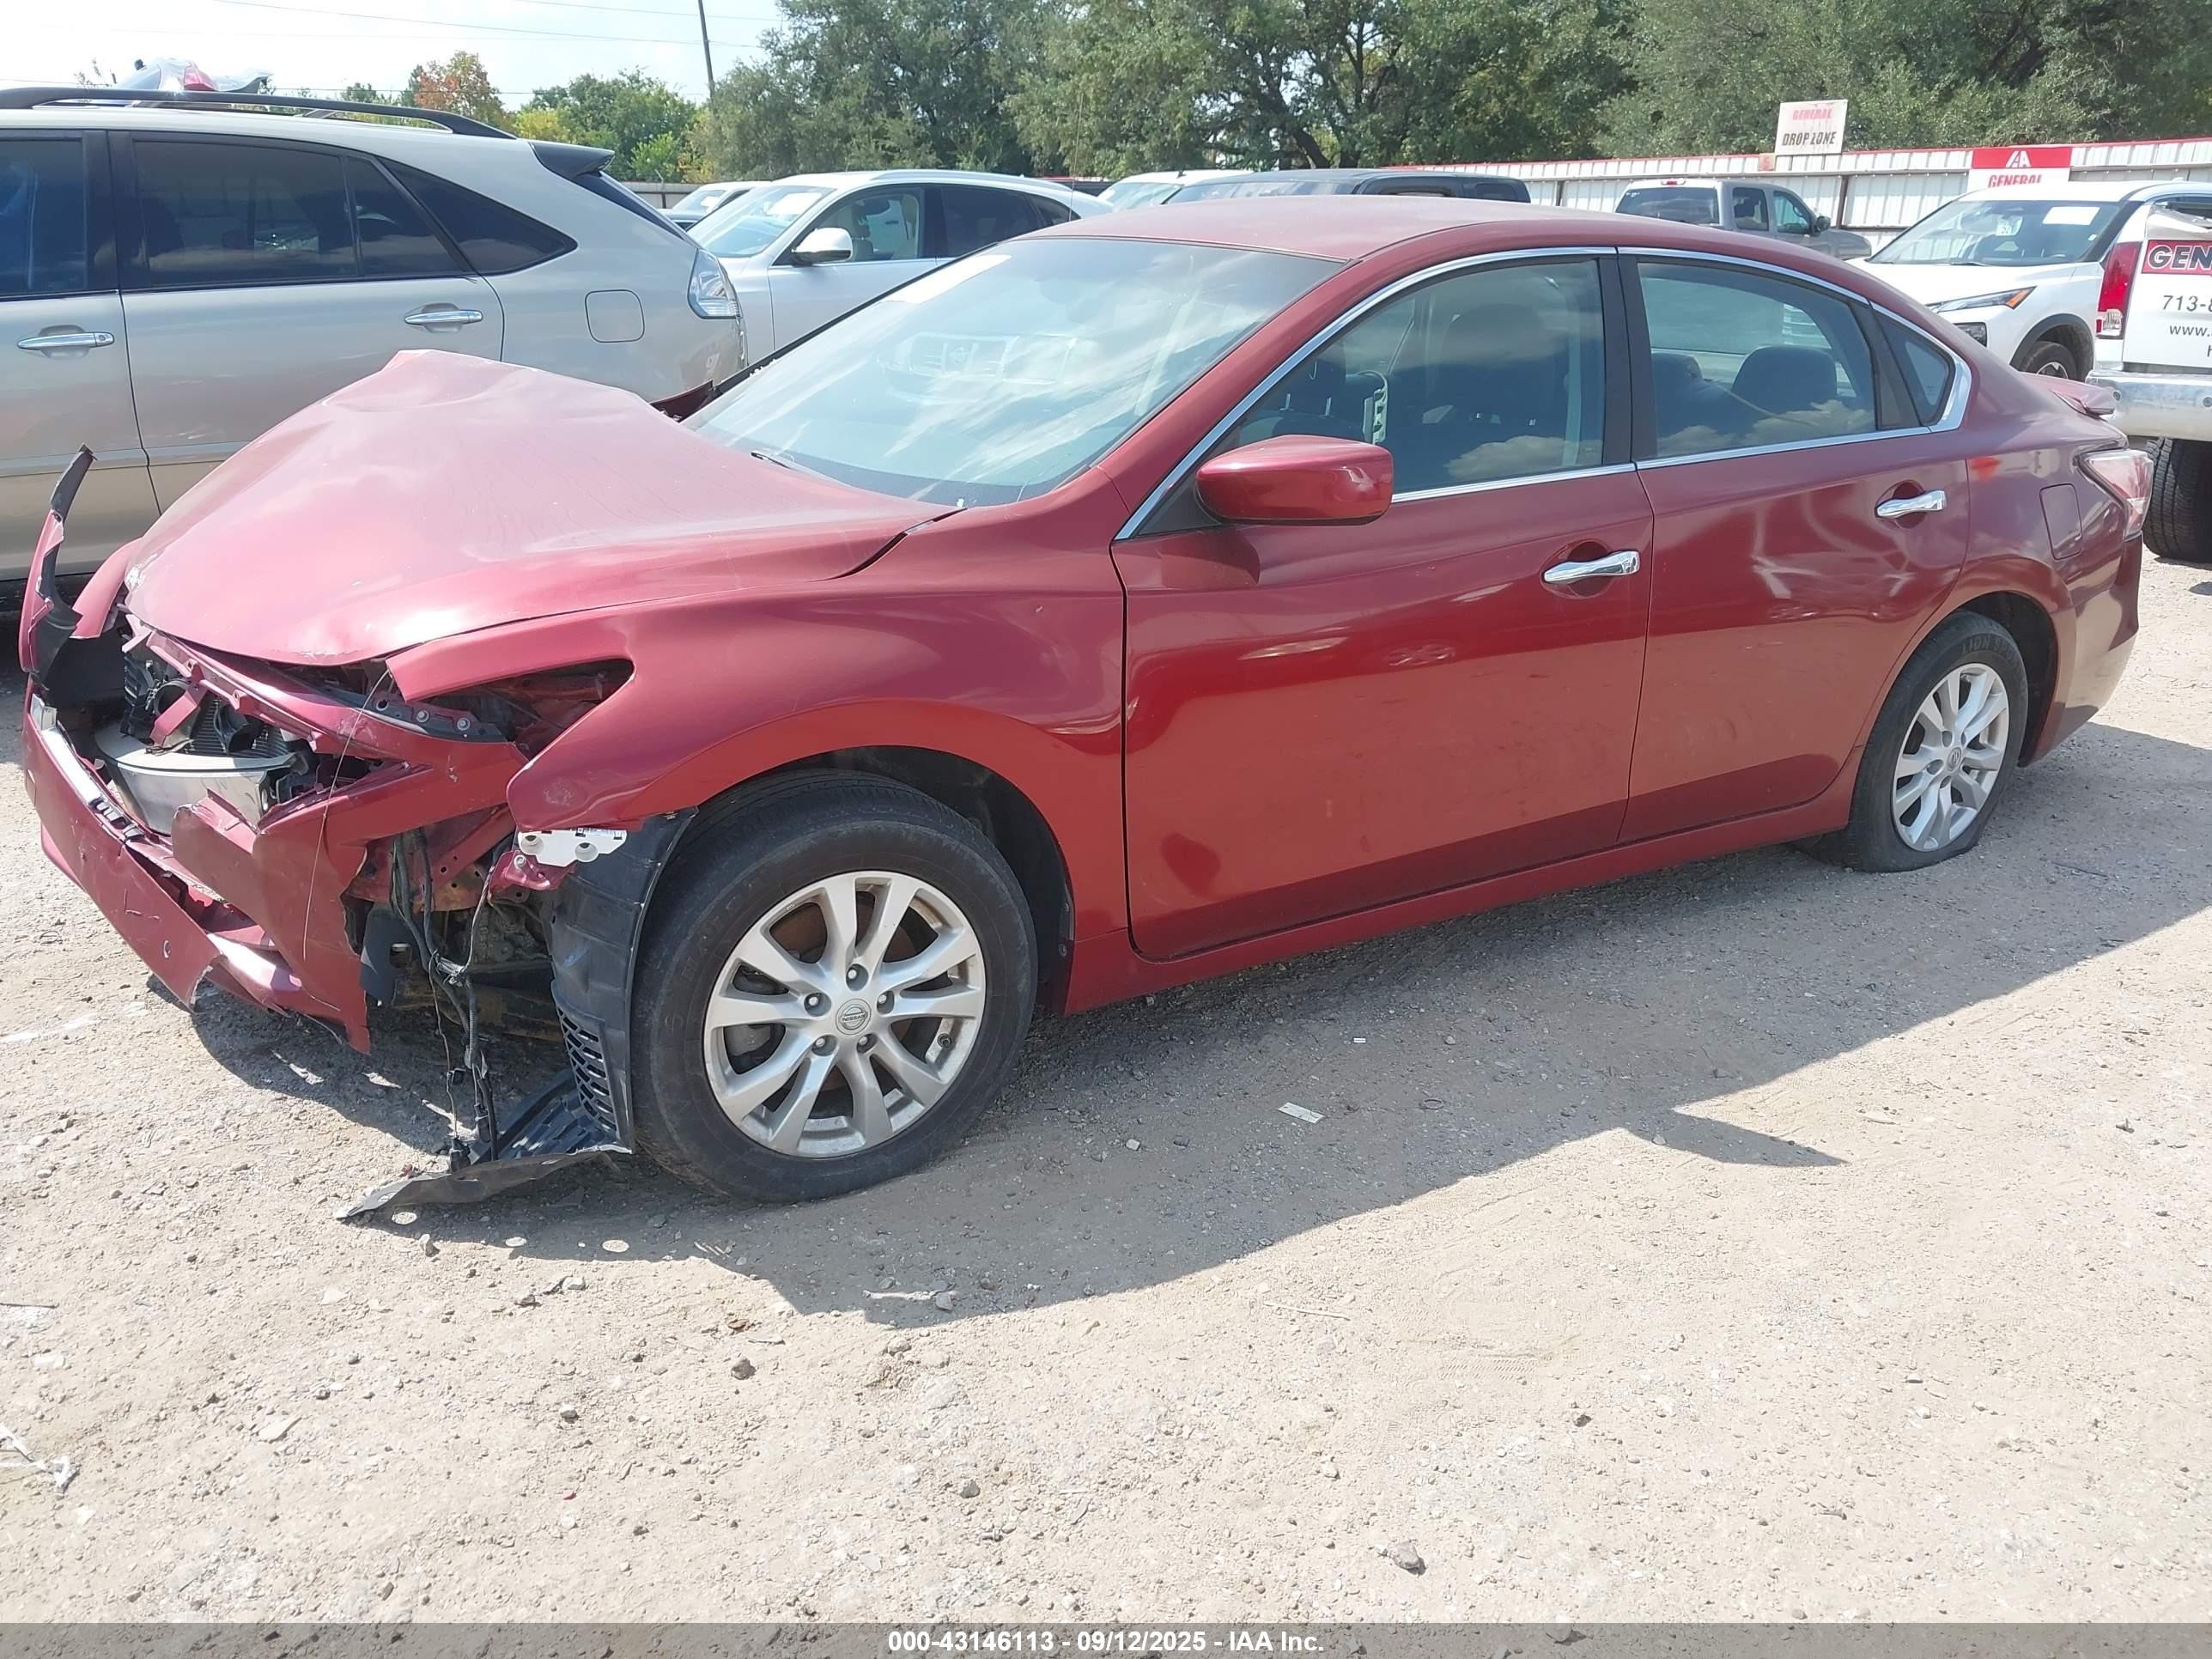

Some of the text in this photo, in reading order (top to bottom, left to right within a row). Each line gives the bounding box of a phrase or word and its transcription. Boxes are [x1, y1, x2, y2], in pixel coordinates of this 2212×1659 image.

[1792, 108, 1832, 120] GENERAL
[1782, 131, 1837, 146] DROP ZONE
